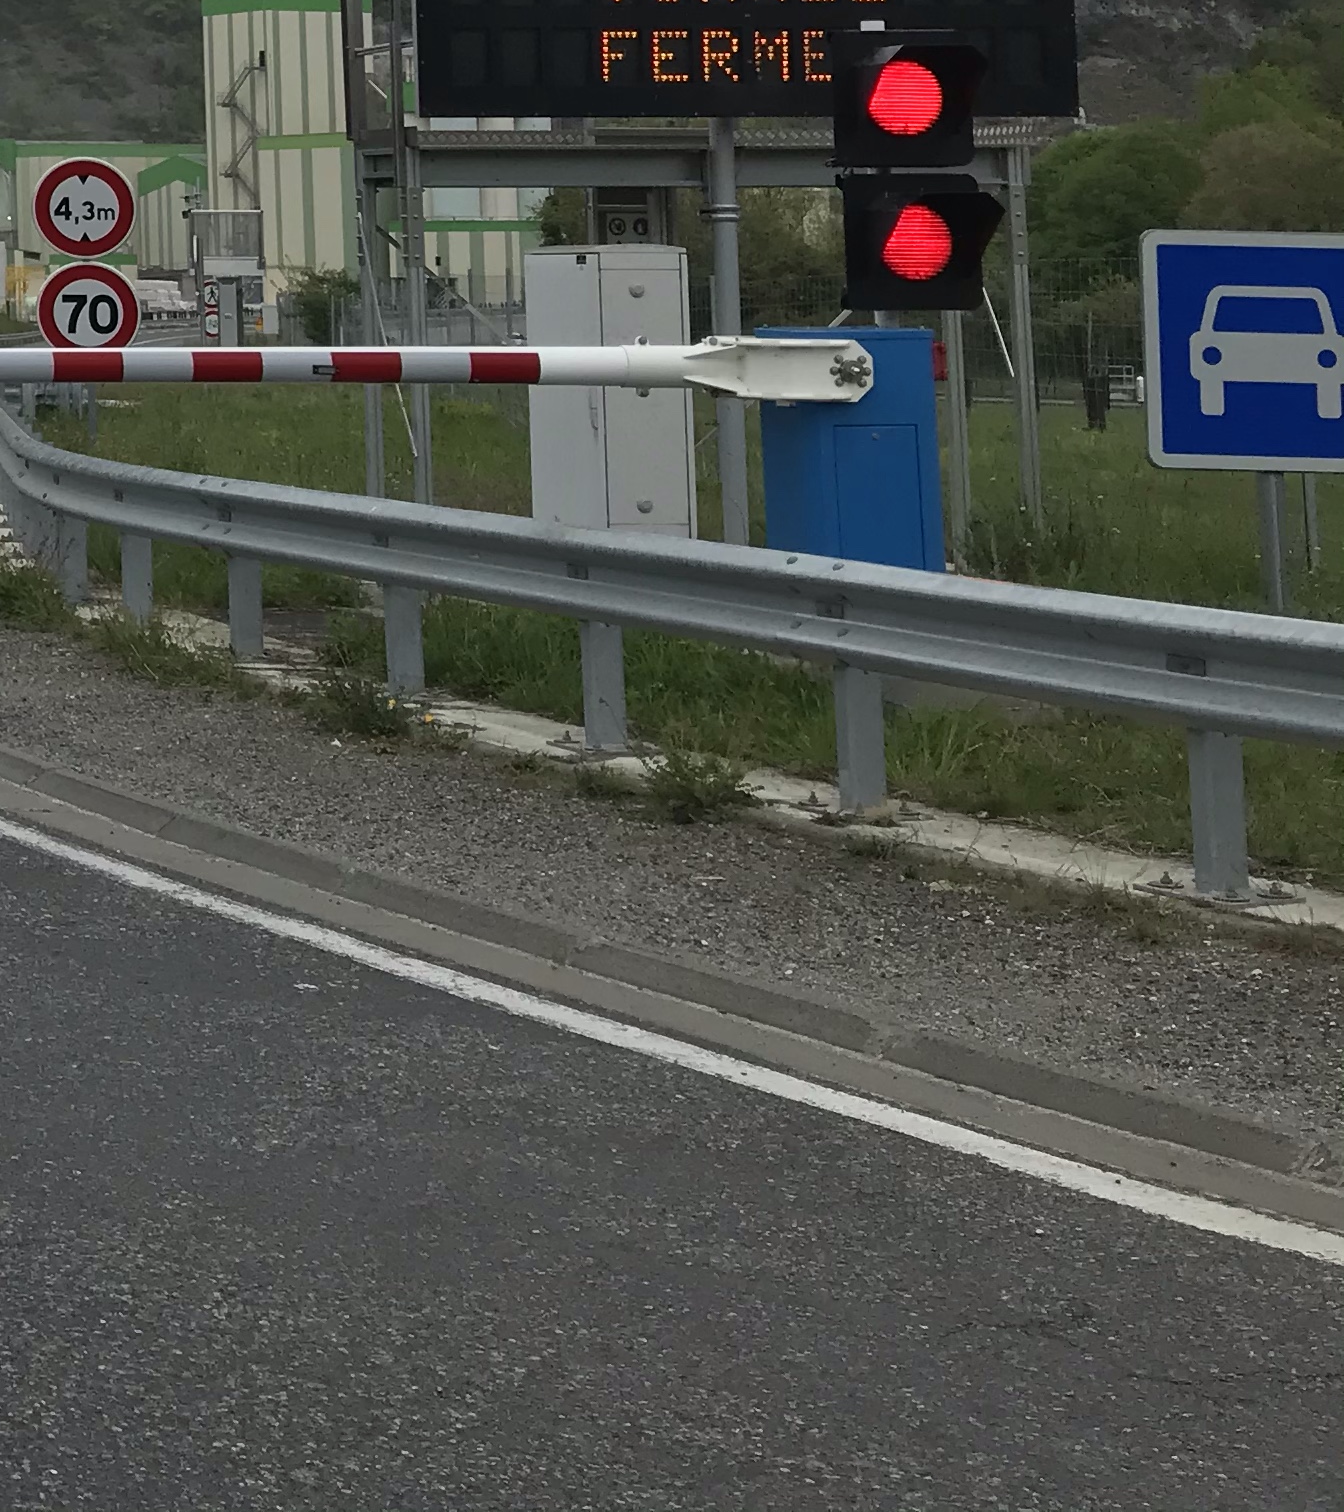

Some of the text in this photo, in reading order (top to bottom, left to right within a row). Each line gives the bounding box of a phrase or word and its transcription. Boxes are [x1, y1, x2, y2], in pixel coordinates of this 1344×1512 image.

[600, 29, 833, 83] FERME
[53, 196, 116, 226] 4,3m
[61, 293, 119, 335] 70
